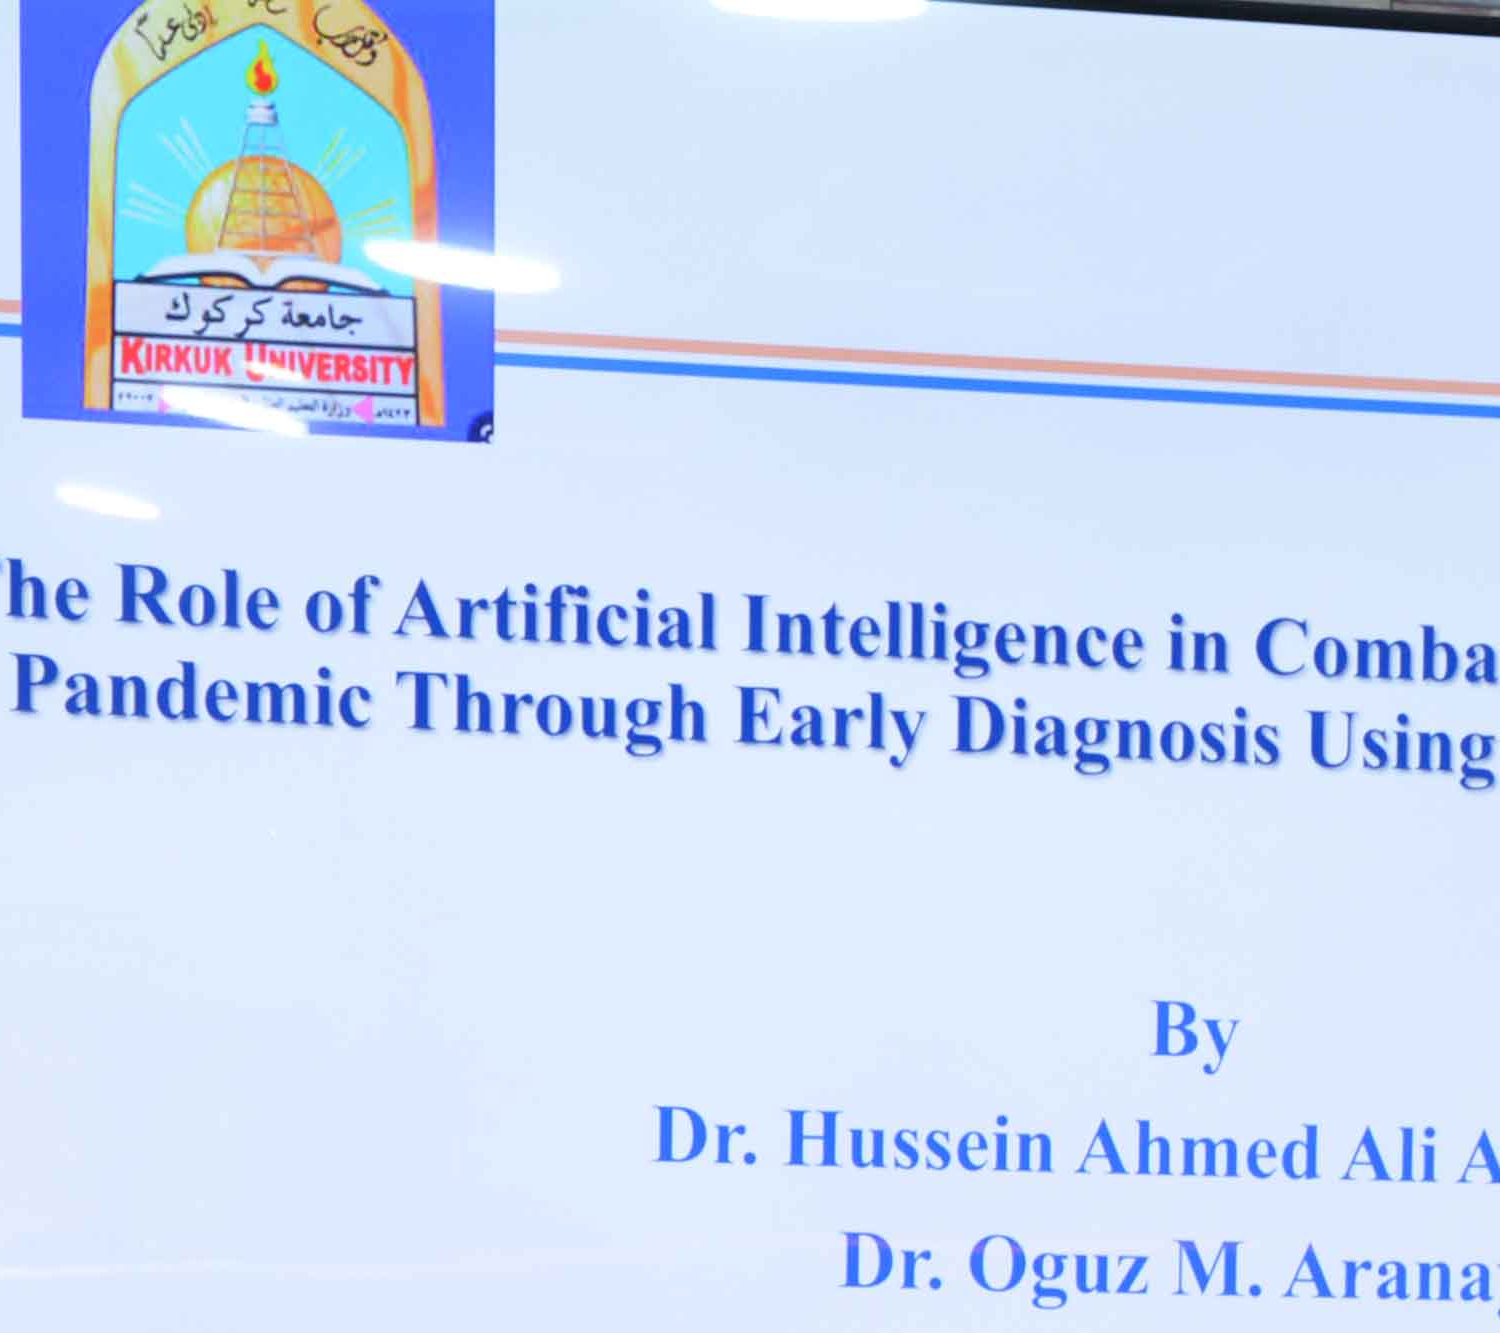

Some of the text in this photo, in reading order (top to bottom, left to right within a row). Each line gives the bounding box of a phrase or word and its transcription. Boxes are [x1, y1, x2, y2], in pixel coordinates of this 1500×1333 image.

[280, 302, 363, 336] جامعة
[116, 563, 281, 632] Role
[306, 575, 380, 634] of
[395, 577, 717, 652] Artificial
[744, 594, 1145, 679] Intelligence
[1169, 612, 1229, 674] in
[13, 652, 373, 729] Pandemic
[395, 671, 708, 758] Through
[737, 686, 927, 769] Early
[954, 695, 1281, 776] Diagnosis
[1307, 710, 1497, 791] Using
[1153, 1000, 1239, 1075] By
[655, 1105, 757, 1165] Dr.
[786, 1109, 1053, 1174] Hussein
[1076, 1119, 1319, 1182] Ahmed
[1342, 1126, 1436, 1183] Ali
[842, 1231, 943, 1291] Dr.
[969, 1235, 1149, 1310] Oguz
[1175, 1240, 1262, 1298] M.
